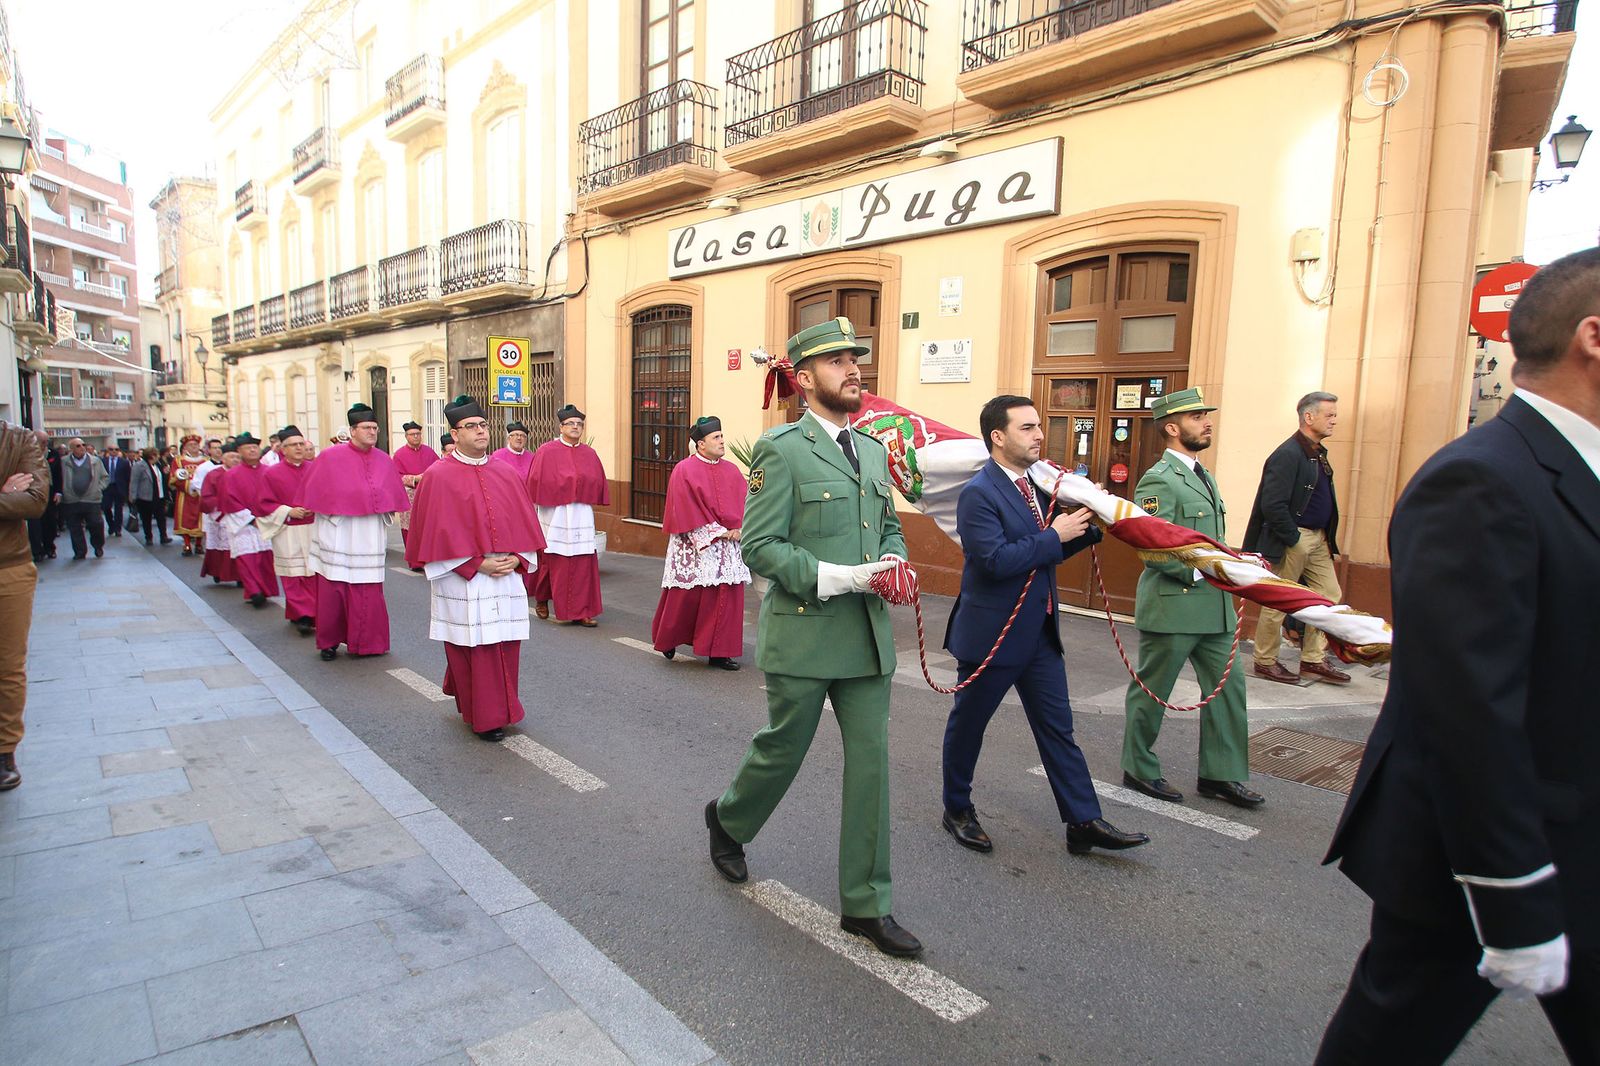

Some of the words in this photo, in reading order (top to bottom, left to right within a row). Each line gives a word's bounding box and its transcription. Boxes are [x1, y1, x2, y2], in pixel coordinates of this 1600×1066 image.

[673, 224, 789, 269] Casa
[845, 171, 1036, 243] Puga
[907, 313, 914, 328] 7
[502, 350, 517, 360] 30
